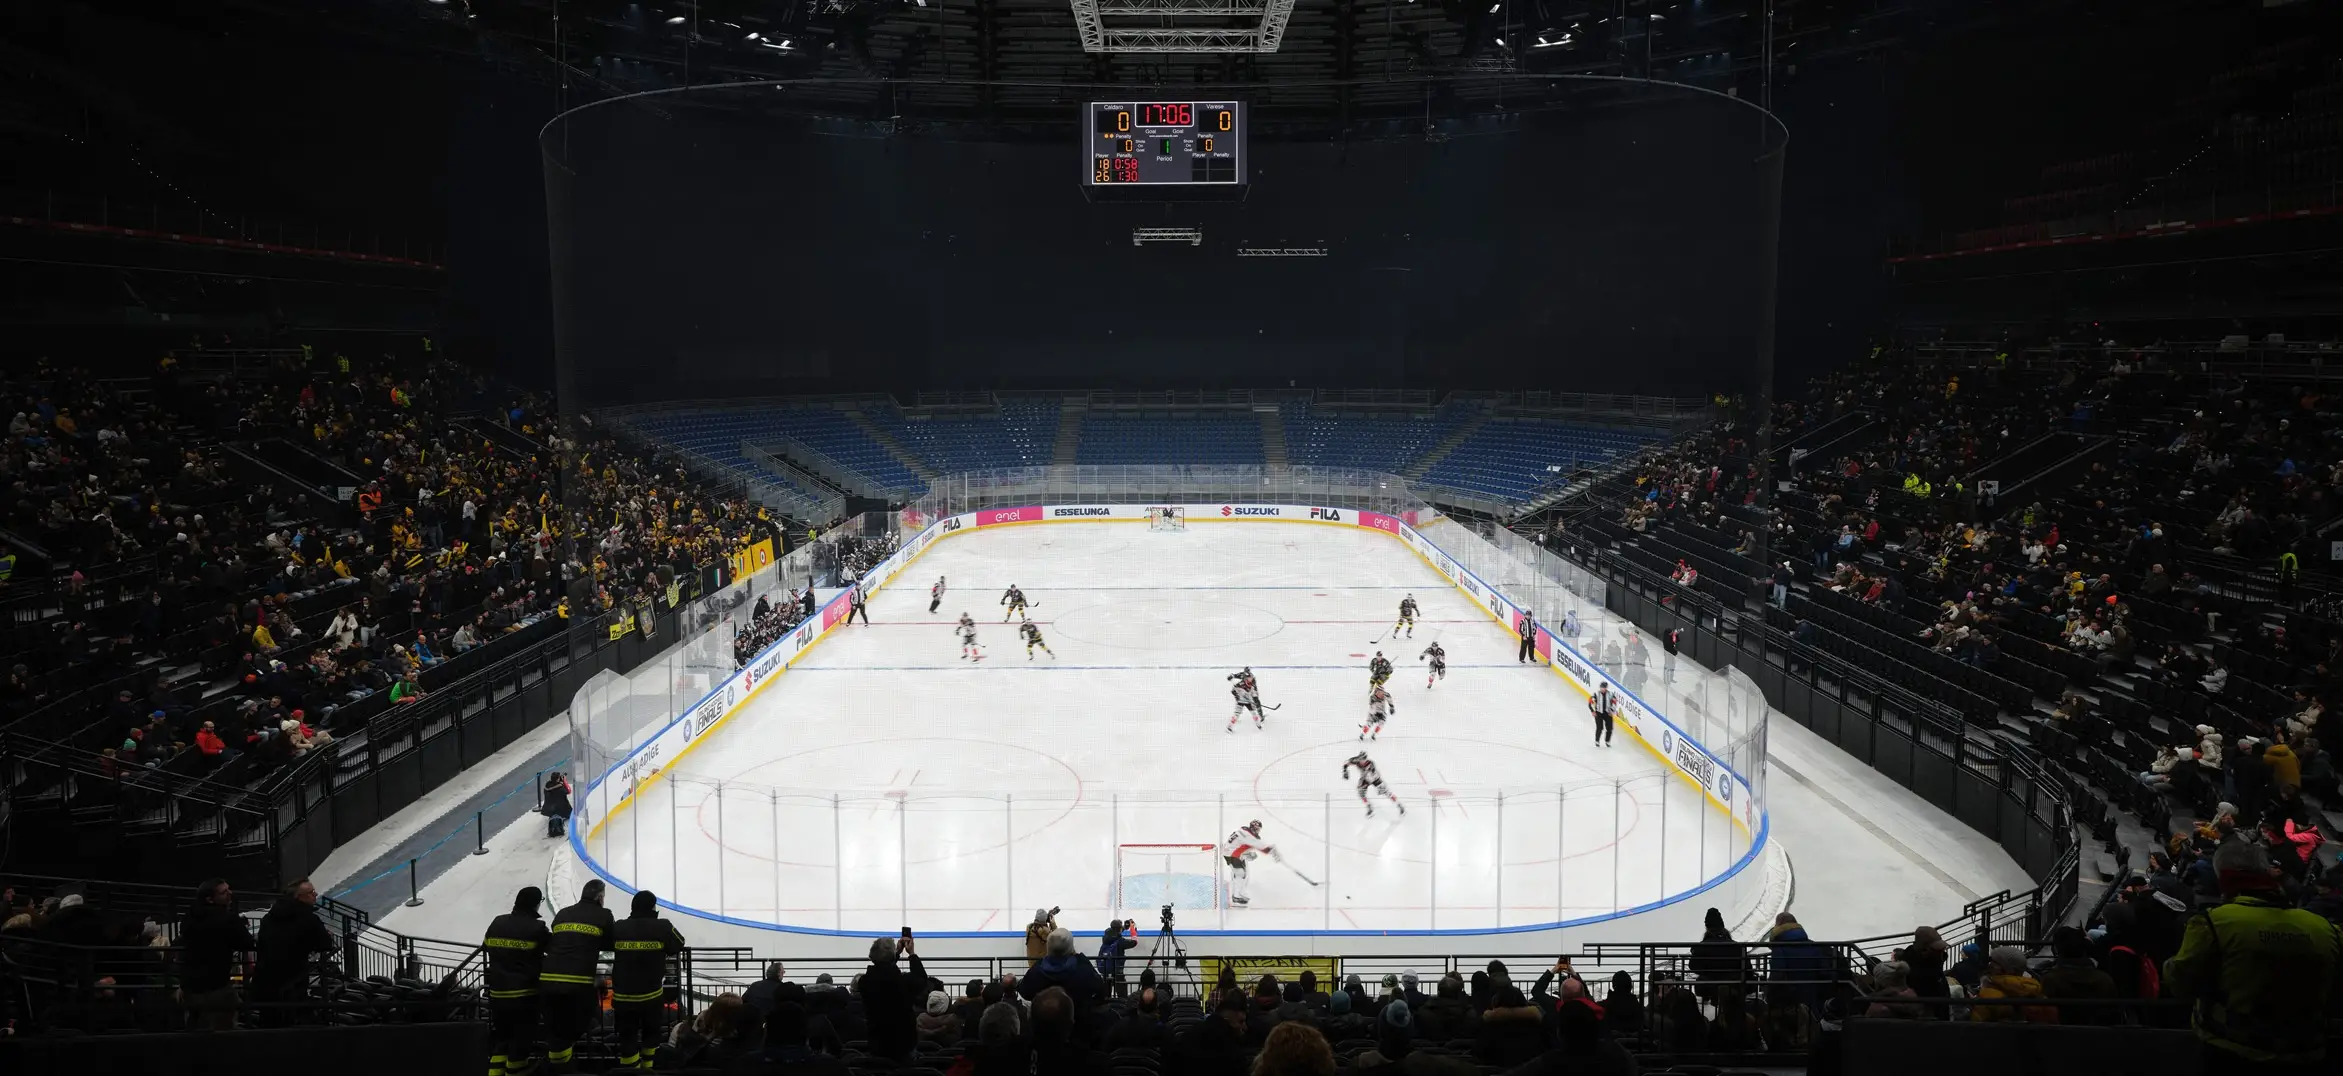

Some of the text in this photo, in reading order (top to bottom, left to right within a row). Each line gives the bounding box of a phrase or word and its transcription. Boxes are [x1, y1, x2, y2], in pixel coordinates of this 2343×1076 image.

[1118, 111, 1129, 131] 0
[1146, 104, 1191, 124] 17:06
[1219, 111, 1231, 131] 0
[1125, 139, 1133, 152] 0
[1205, 139, 1213, 152] 0
[1099, 158, 1110, 169] 18
[1114, 158, 1138, 169] 0:58
[1095, 171, 1110, 182] 26
[1119, 171, 1138, 182] 1:30
[995, 508, 1020, 522] enel
[1054, 507, 1110, 516] ESSELUNGA
[1234, 507, 1280, 516] SUZUKI
[1310, 507, 1341, 521] FILA
[943, 517, 961, 533] FILA
[1374, 517, 1390, 530] enel
[832, 599, 844, 620] enel
[1490, 593, 1504, 619] FILA
[796, 623, 813, 651] FILA
[753, 652, 780, 683] SUZUKI
[1557, 648, 1591, 687] ESSELUNGA
[698, 701, 722, 731] FINALS
[1678, 749, 1712, 784] FINALS
[576, 925, 596, 933] FUOCO
